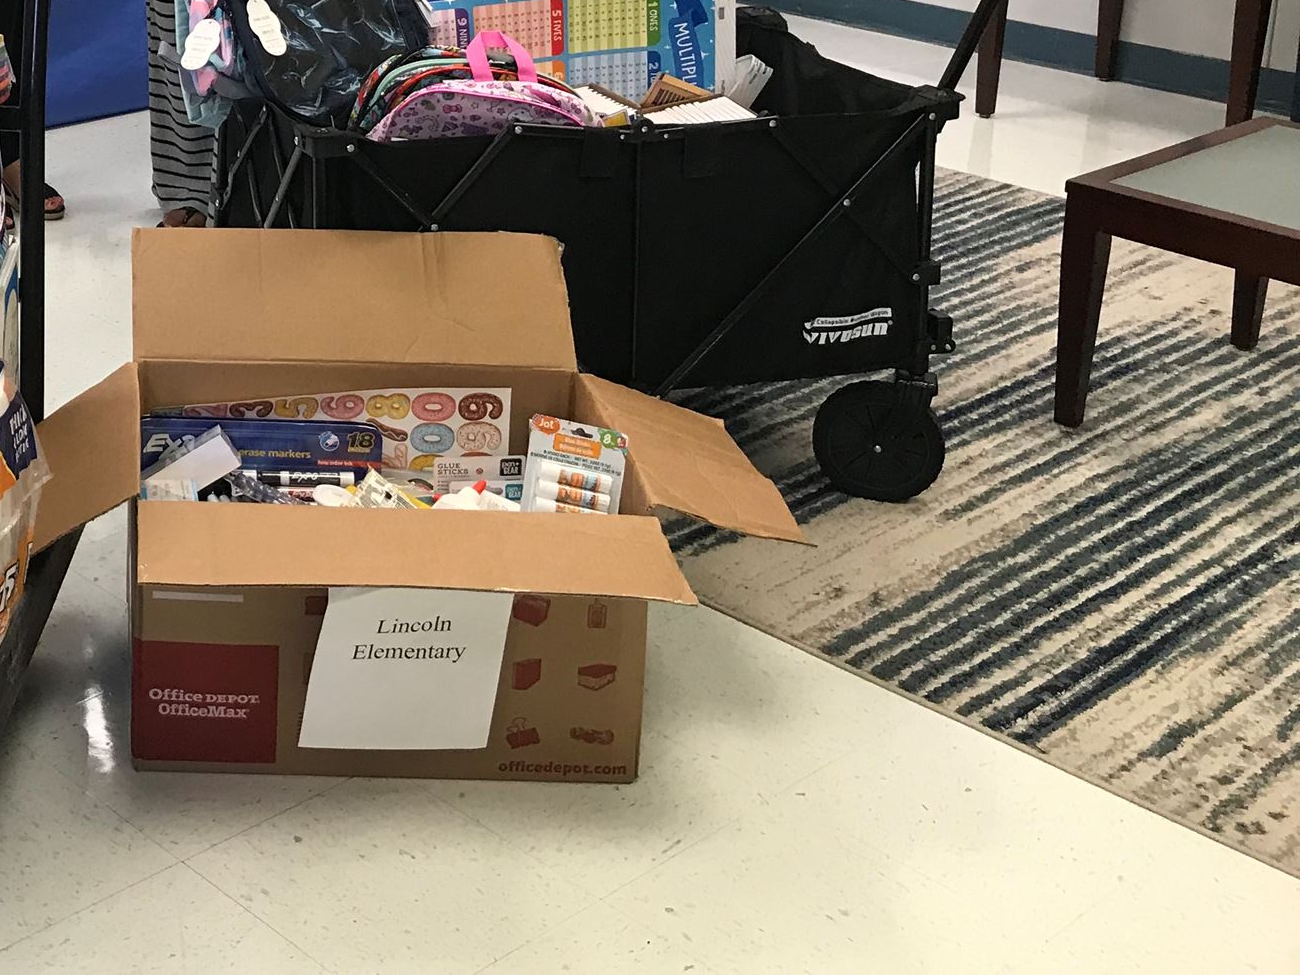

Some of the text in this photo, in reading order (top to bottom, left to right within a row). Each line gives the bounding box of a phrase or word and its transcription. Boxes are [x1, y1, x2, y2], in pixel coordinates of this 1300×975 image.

[458, 17, 467, 26] 9
[552, 9, 562, 42] 5 FIVES
[649, 9, 659, 31] ONES
[648, 61, 659, 70] 2
[539, 418, 555, 429] Jot
[347, 431, 375, 449] 18
[602, 433, 612, 444] 8
[267, 448, 312, 460] markers
[376, 615, 452, 635] Lincoln
[352, 643, 467, 664] Elementary
[149, 688, 203, 702] Office
[158, 703, 249, 719] OfficeMax
[498, 760, 627, 776] officedepot.com
